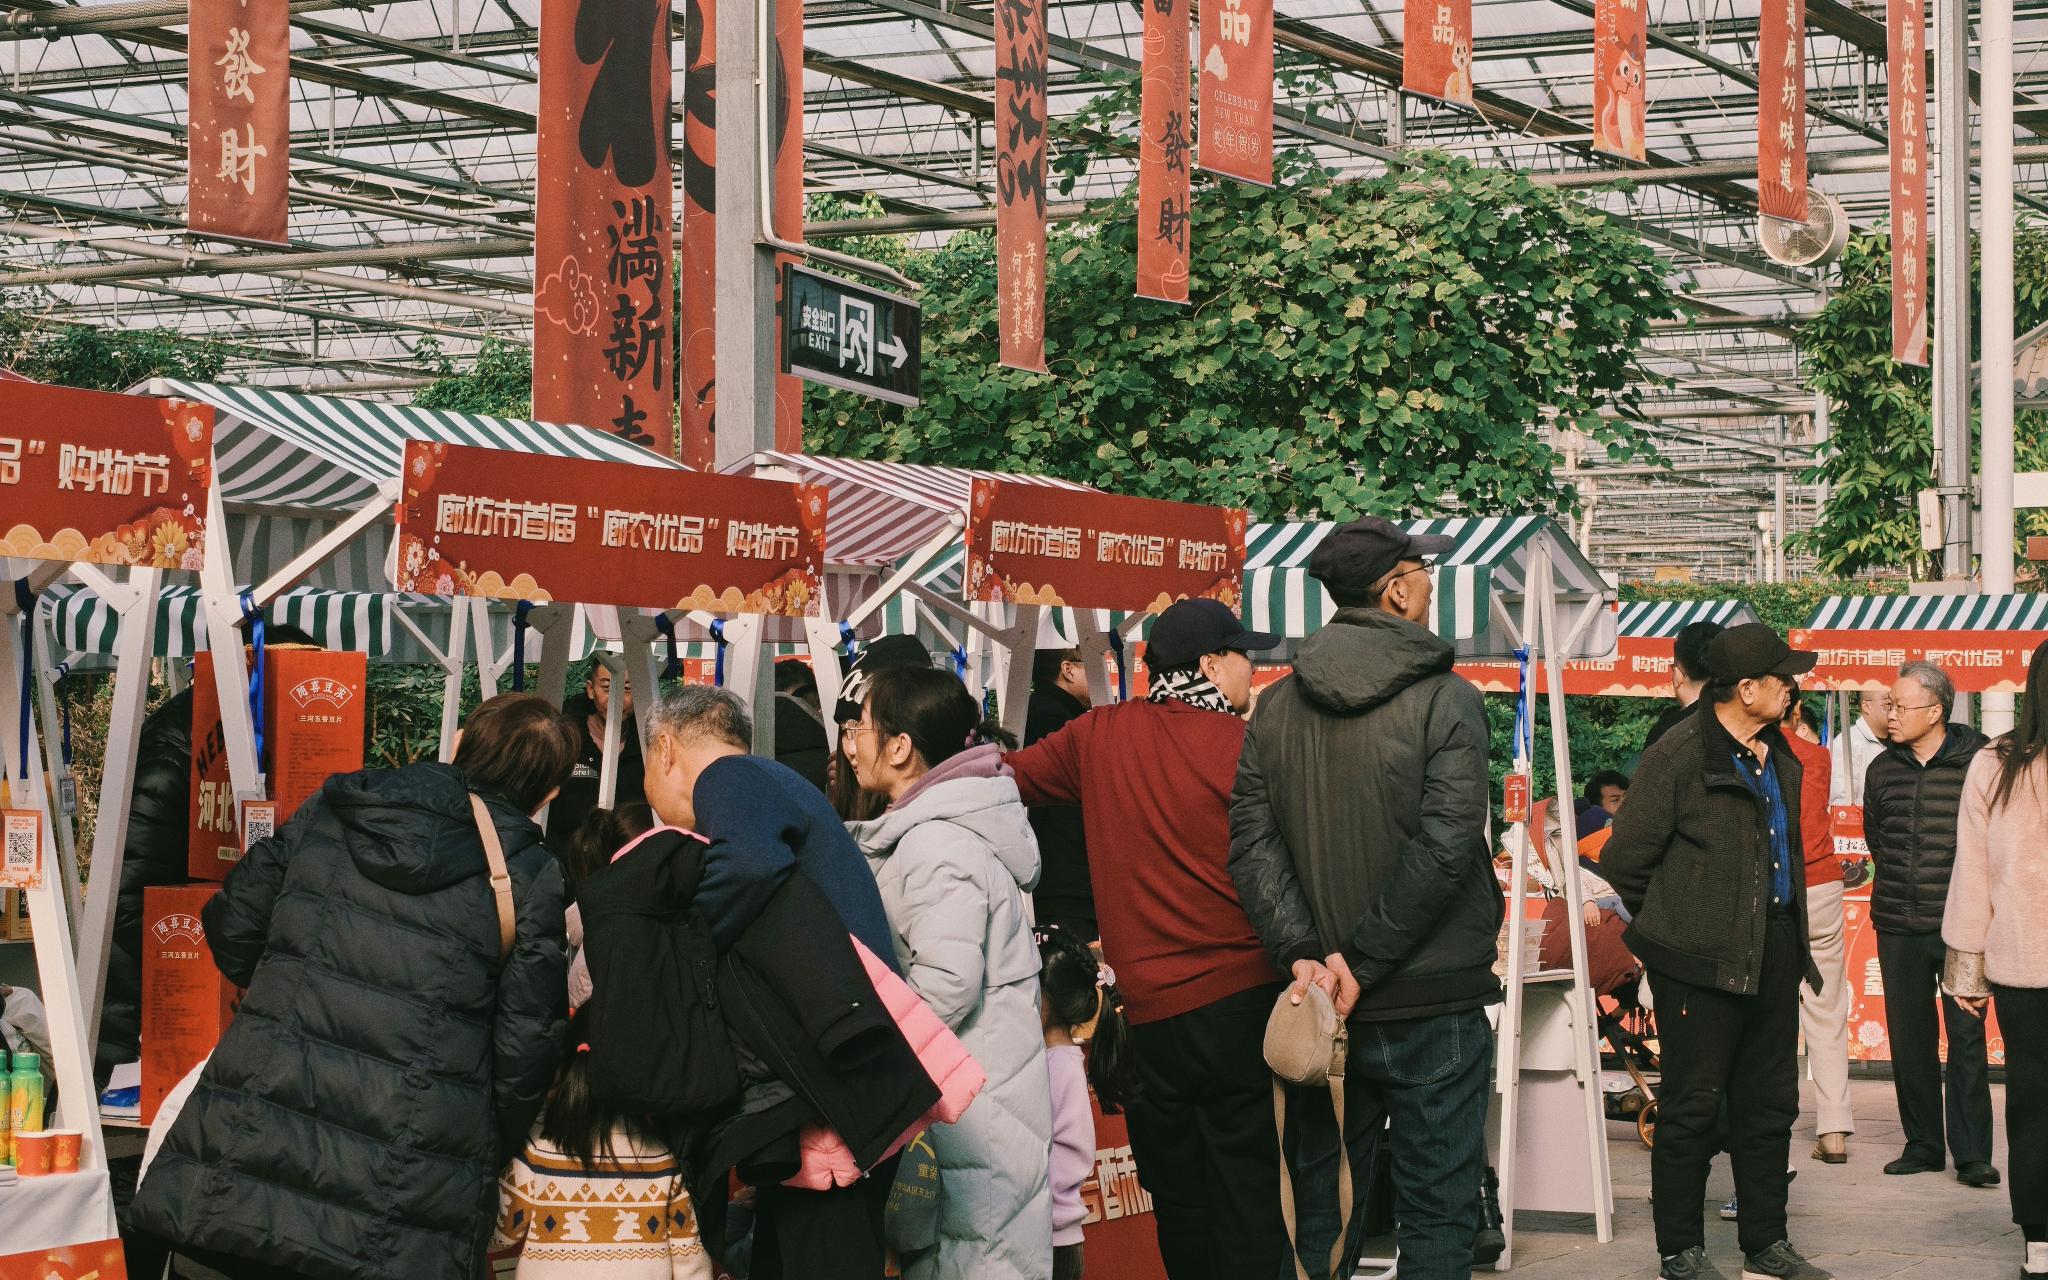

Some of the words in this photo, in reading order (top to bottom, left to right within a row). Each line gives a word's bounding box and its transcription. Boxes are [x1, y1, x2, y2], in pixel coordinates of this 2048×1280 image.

[1432, 4, 1456, 47] 品
[214, 0, 267, 196] 發財
[1214, 89, 1260, 112] CELEBRATE
[1215, 106, 1231, 120] NEW
[1234, 111, 1256, 127] YEAR
[802, 304, 836, 335] 安全出口
[808, 332, 831, 352] EXIT
